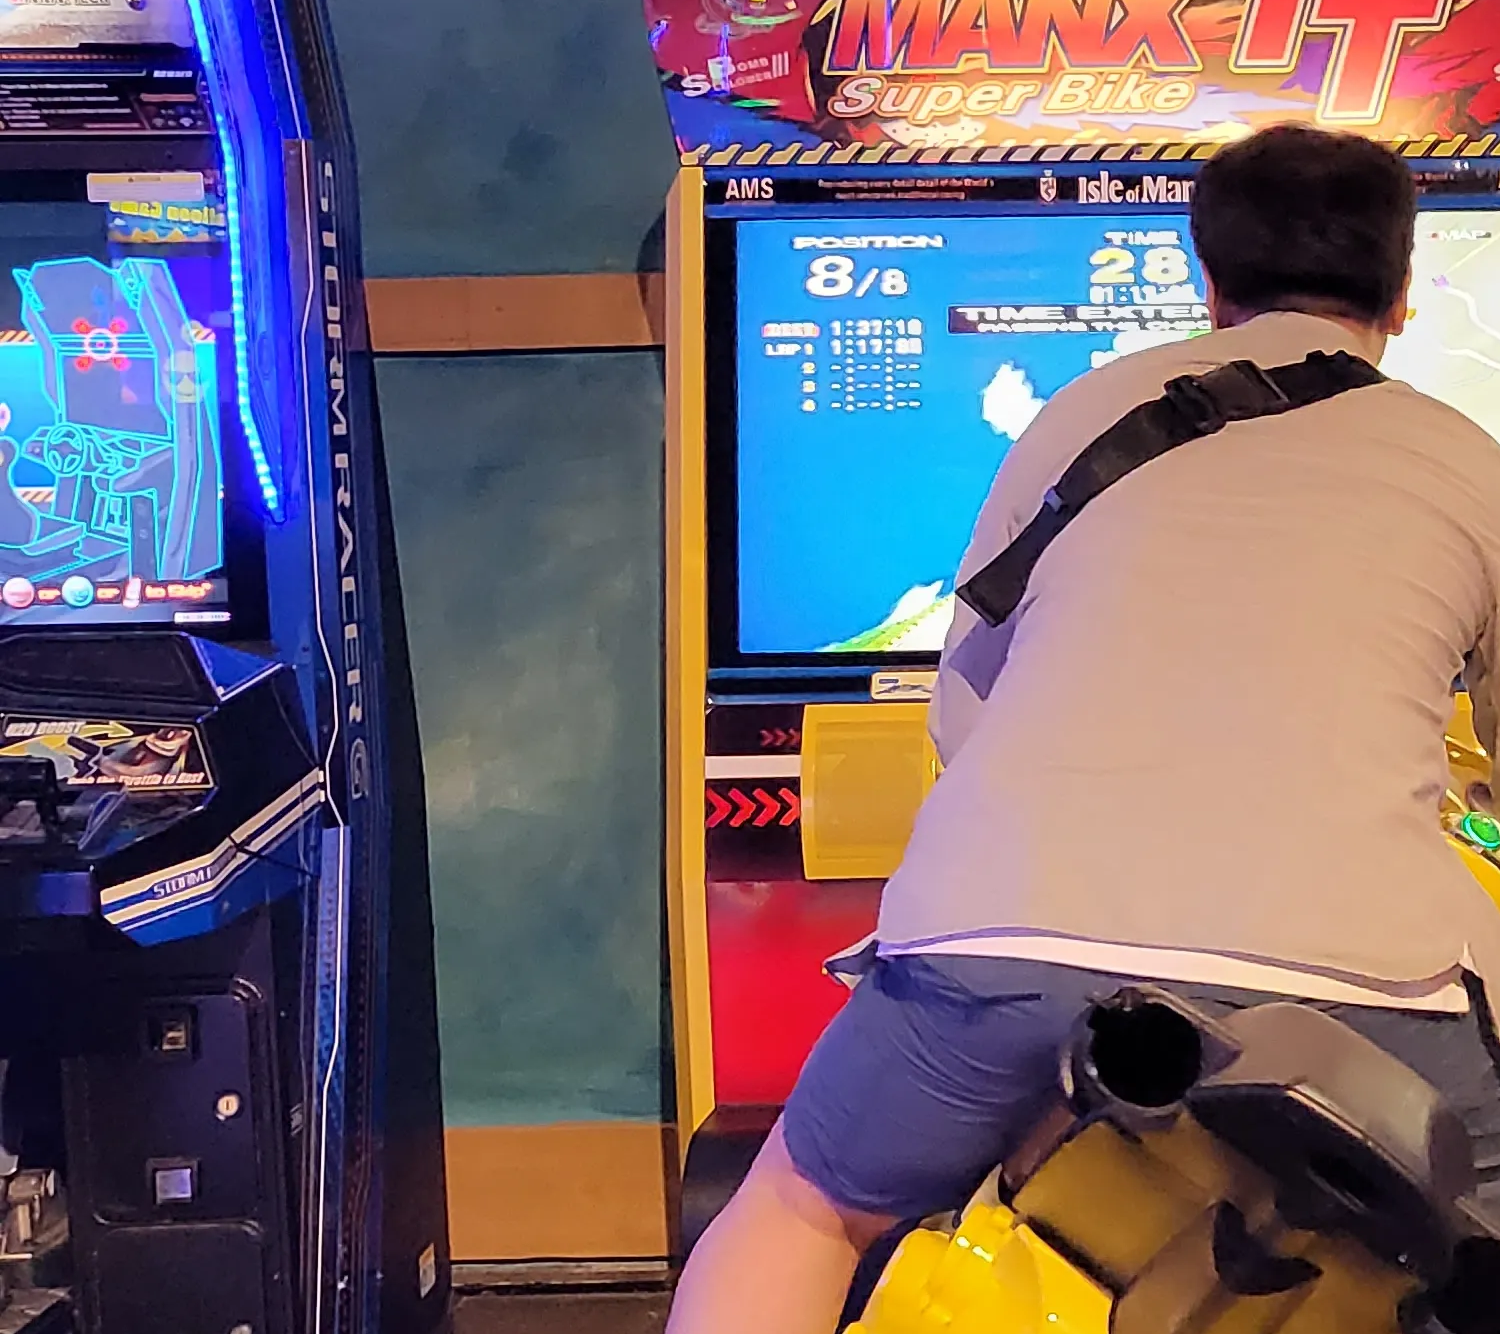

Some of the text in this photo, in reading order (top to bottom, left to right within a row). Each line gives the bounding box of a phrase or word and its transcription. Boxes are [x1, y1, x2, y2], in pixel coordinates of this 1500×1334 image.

[829, 70, 1196, 124] Super Bike
[725, 177, 775, 200] AMS
[1078, 170, 1125, 204] Isle
[1125, 184, 1141, 204] of
[793, 234, 945, 250] POSITION
[1104, 231, 1181, 246] TIME
[1438, 230, 1488, 241] MAP
[805, 254, 909, 298] 8/8
[1089, 246, 1190, 285] 28
[956, 306, 1066, 321] TIME
[334, 453, 362, 724] RACER
